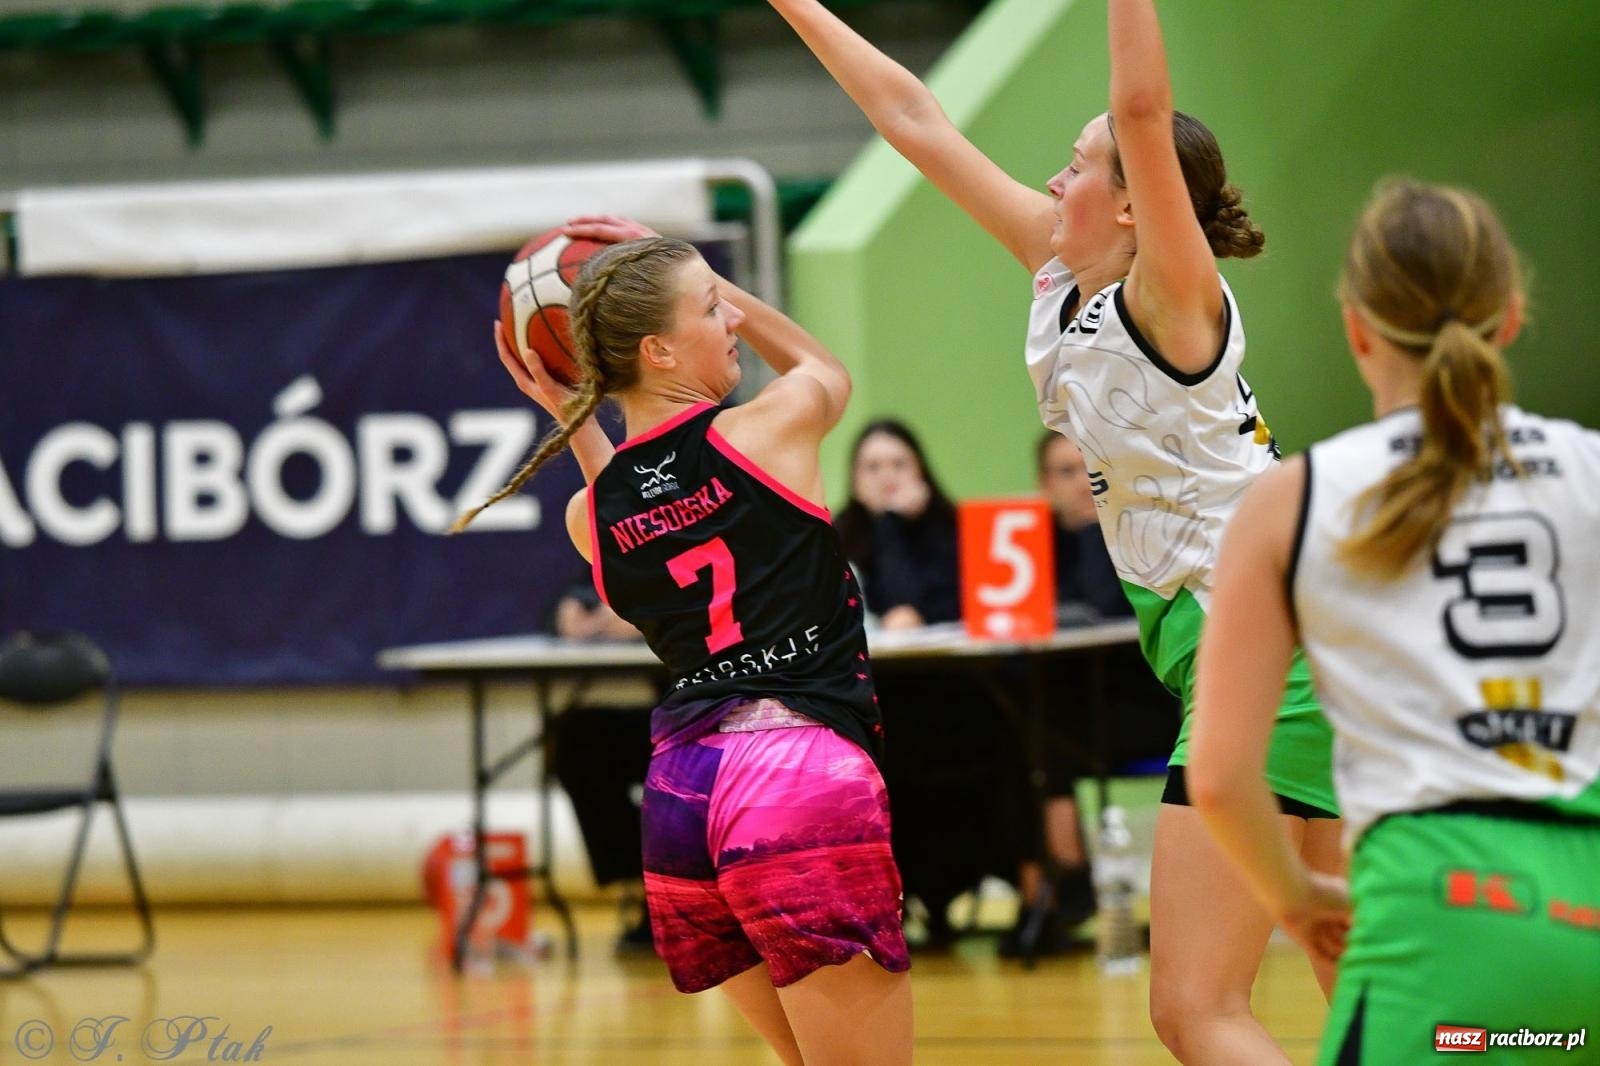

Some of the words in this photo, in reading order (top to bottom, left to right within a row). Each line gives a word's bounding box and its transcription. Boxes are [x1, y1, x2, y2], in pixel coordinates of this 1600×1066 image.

[666, 536, 744, 655] 7
[976, 509, 1038, 608] 5
[1430, 510, 1566, 660] 3
